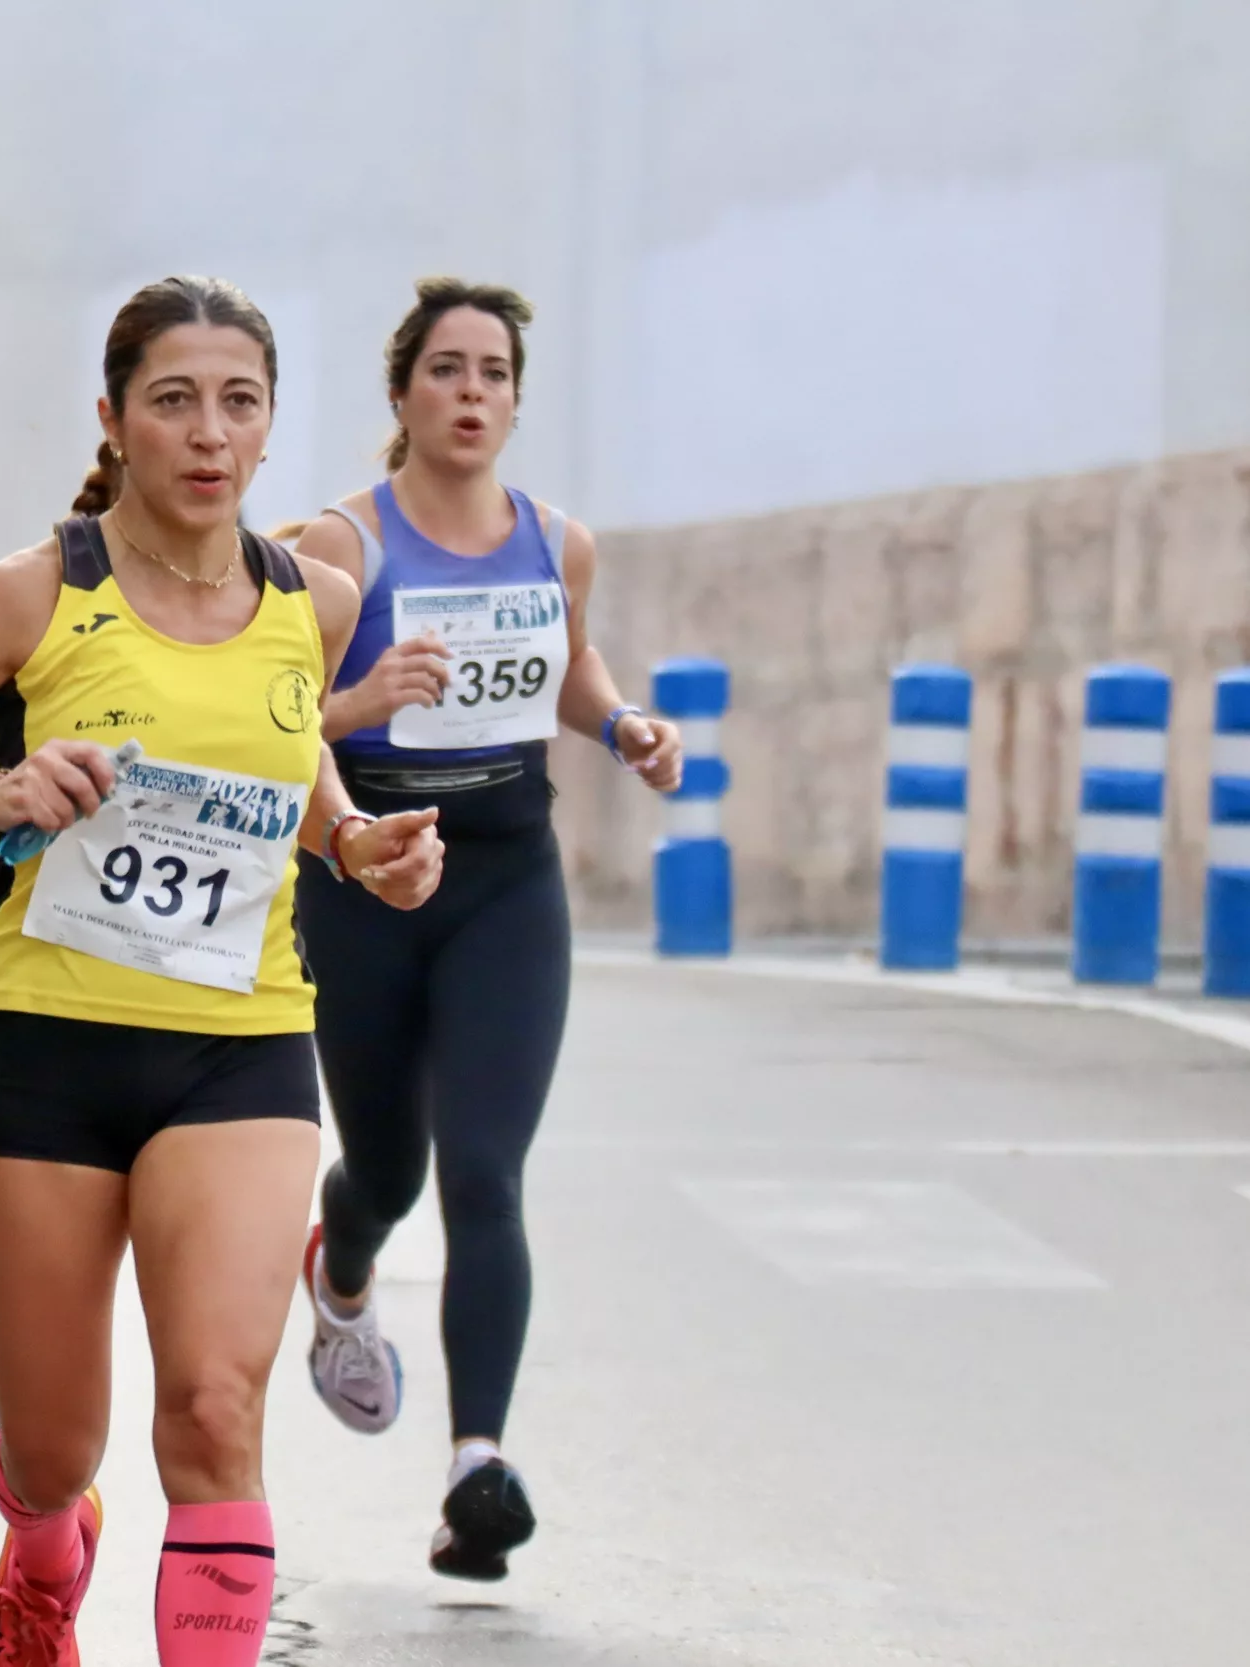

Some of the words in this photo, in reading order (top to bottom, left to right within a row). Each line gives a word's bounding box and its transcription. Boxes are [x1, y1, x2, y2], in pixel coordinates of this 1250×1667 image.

[136, 765, 192, 787] PROVINCIAL
[144, 778, 205, 798] POPULARES
[205, 777, 262, 808] 2024
[138, 832, 156, 843] POR
[157, 837, 170, 847] LA
[171, 840, 218, 858] IGUALDAD
[161, 825, 193, 838] CIUDAD
[195, 833, 207, 843] DE
[100, 845, 230, 927] 931
[86, 914, 132, 934] DOLORES
[195, 942, 247, 960] ZAMORANO
[173, 1613, 258, 1635] SPORTLAST
